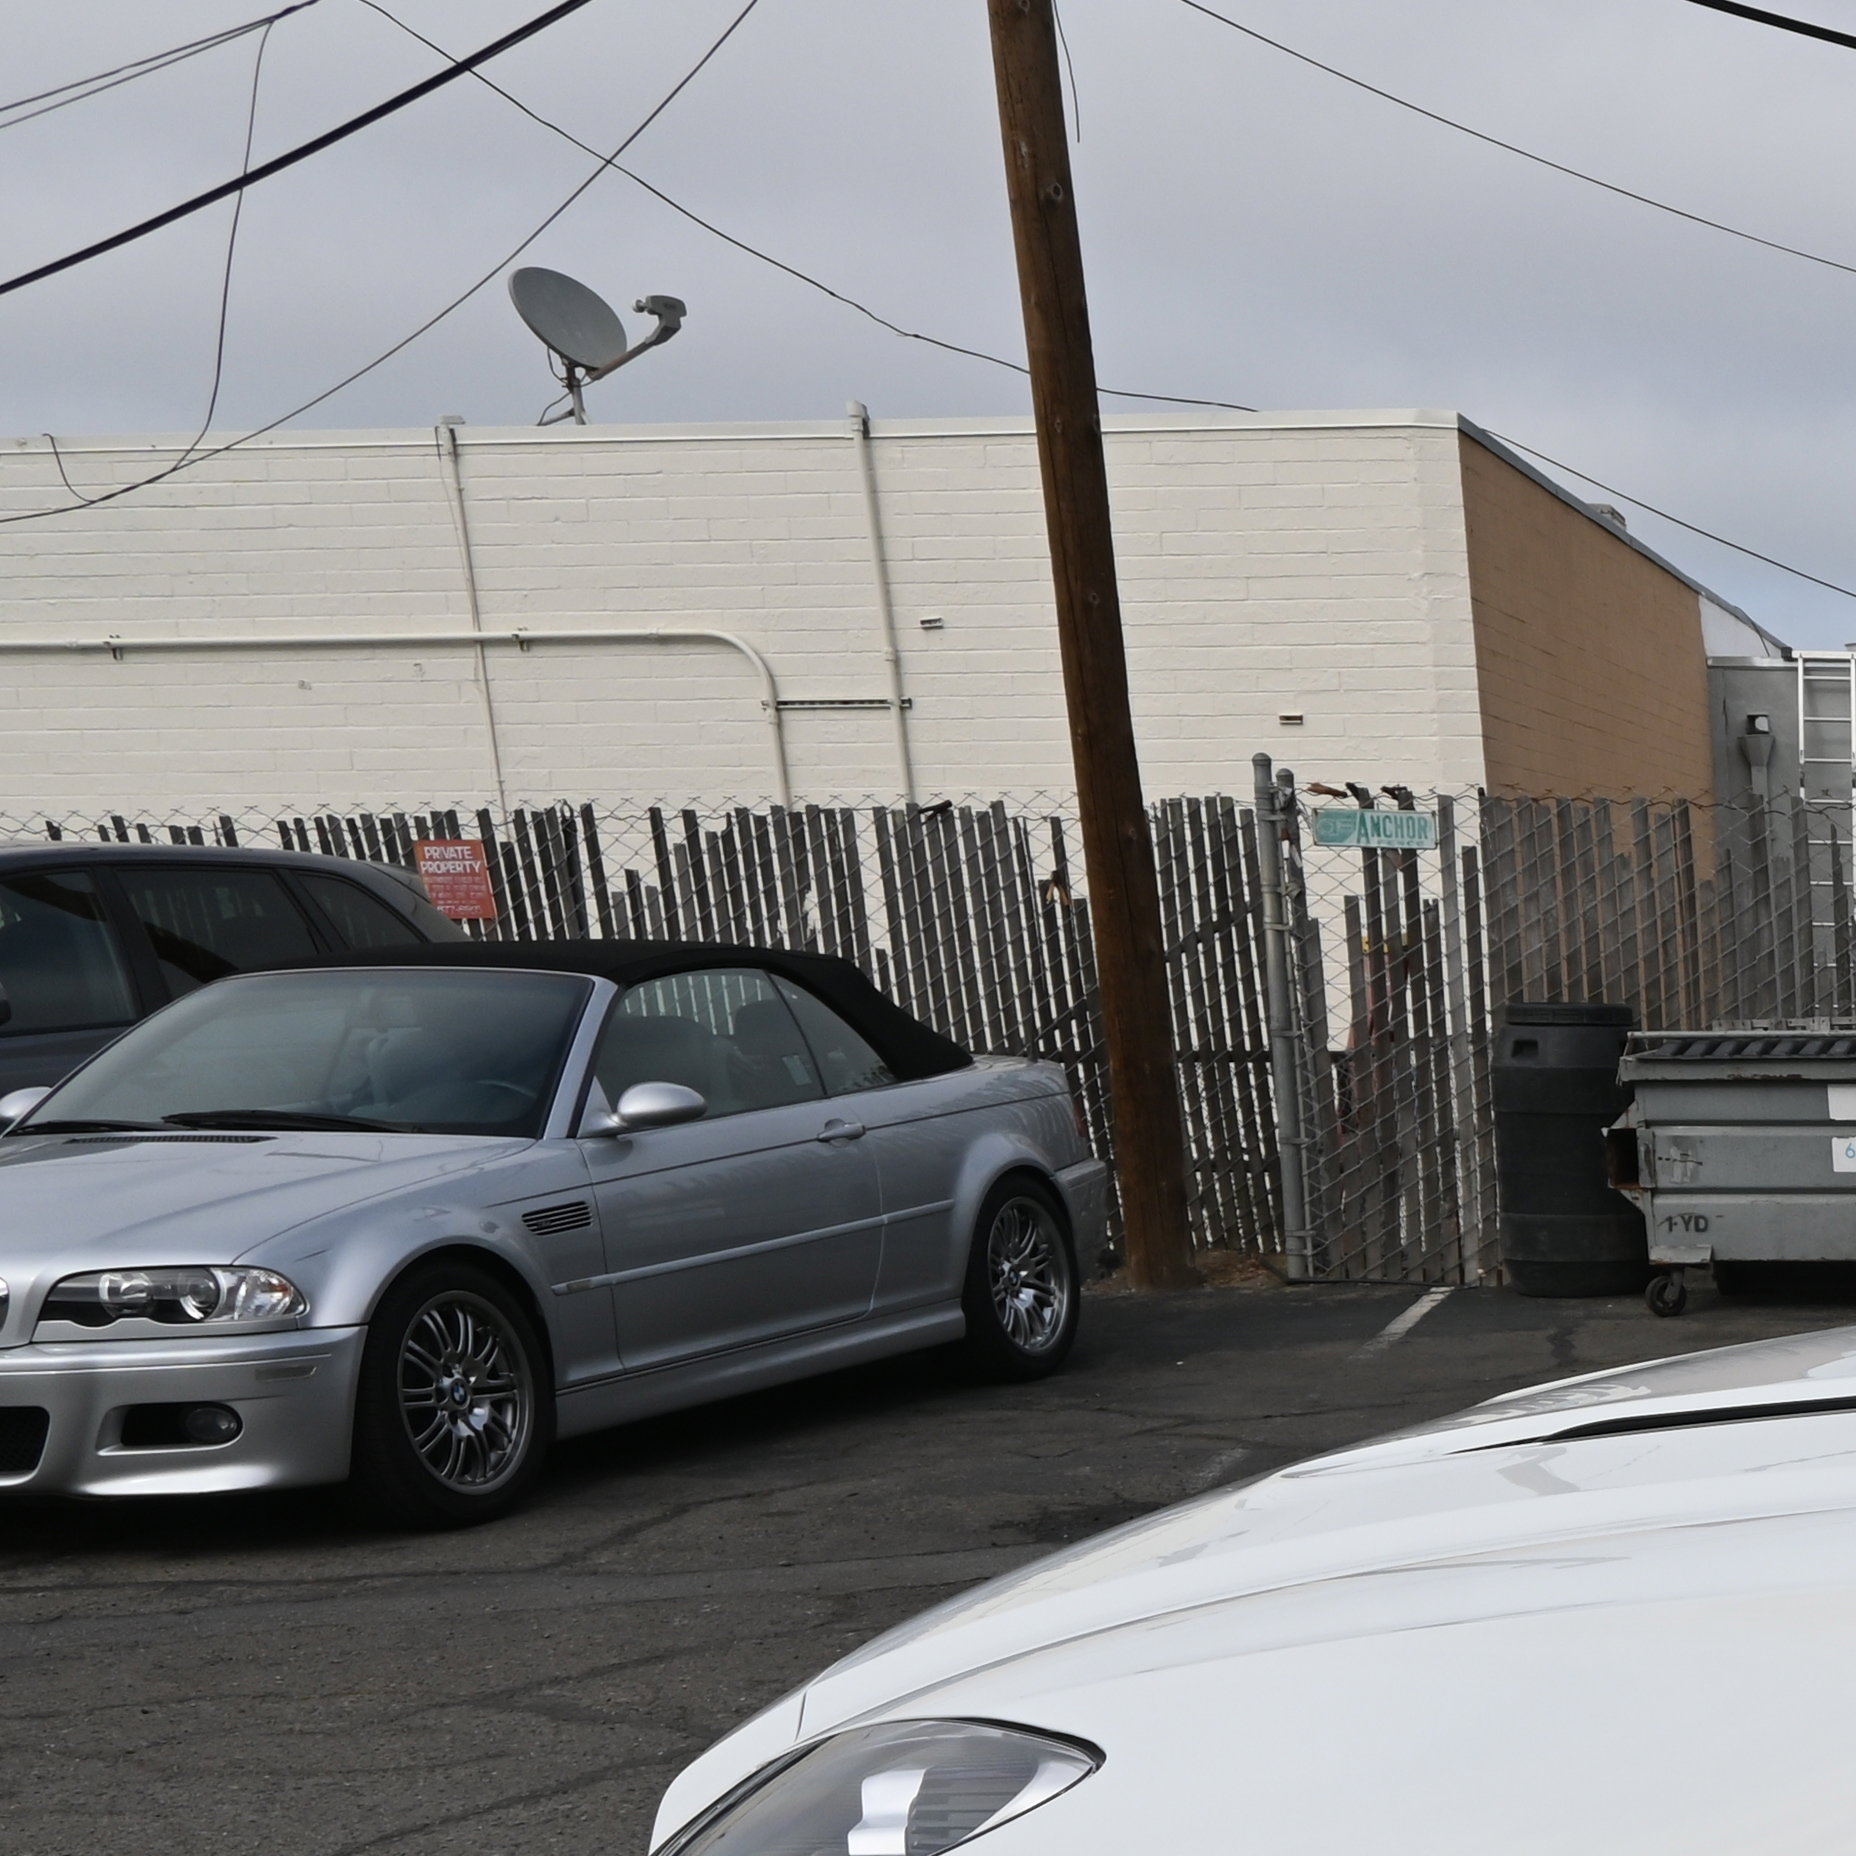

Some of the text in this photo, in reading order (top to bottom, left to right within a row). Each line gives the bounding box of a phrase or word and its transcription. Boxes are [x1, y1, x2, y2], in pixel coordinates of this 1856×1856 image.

[1356, 812, 1429, 844] ANCHOR
[423, 846, 473, 860] PRIVATE
[420, 861, 481, 875] PROPERTY
